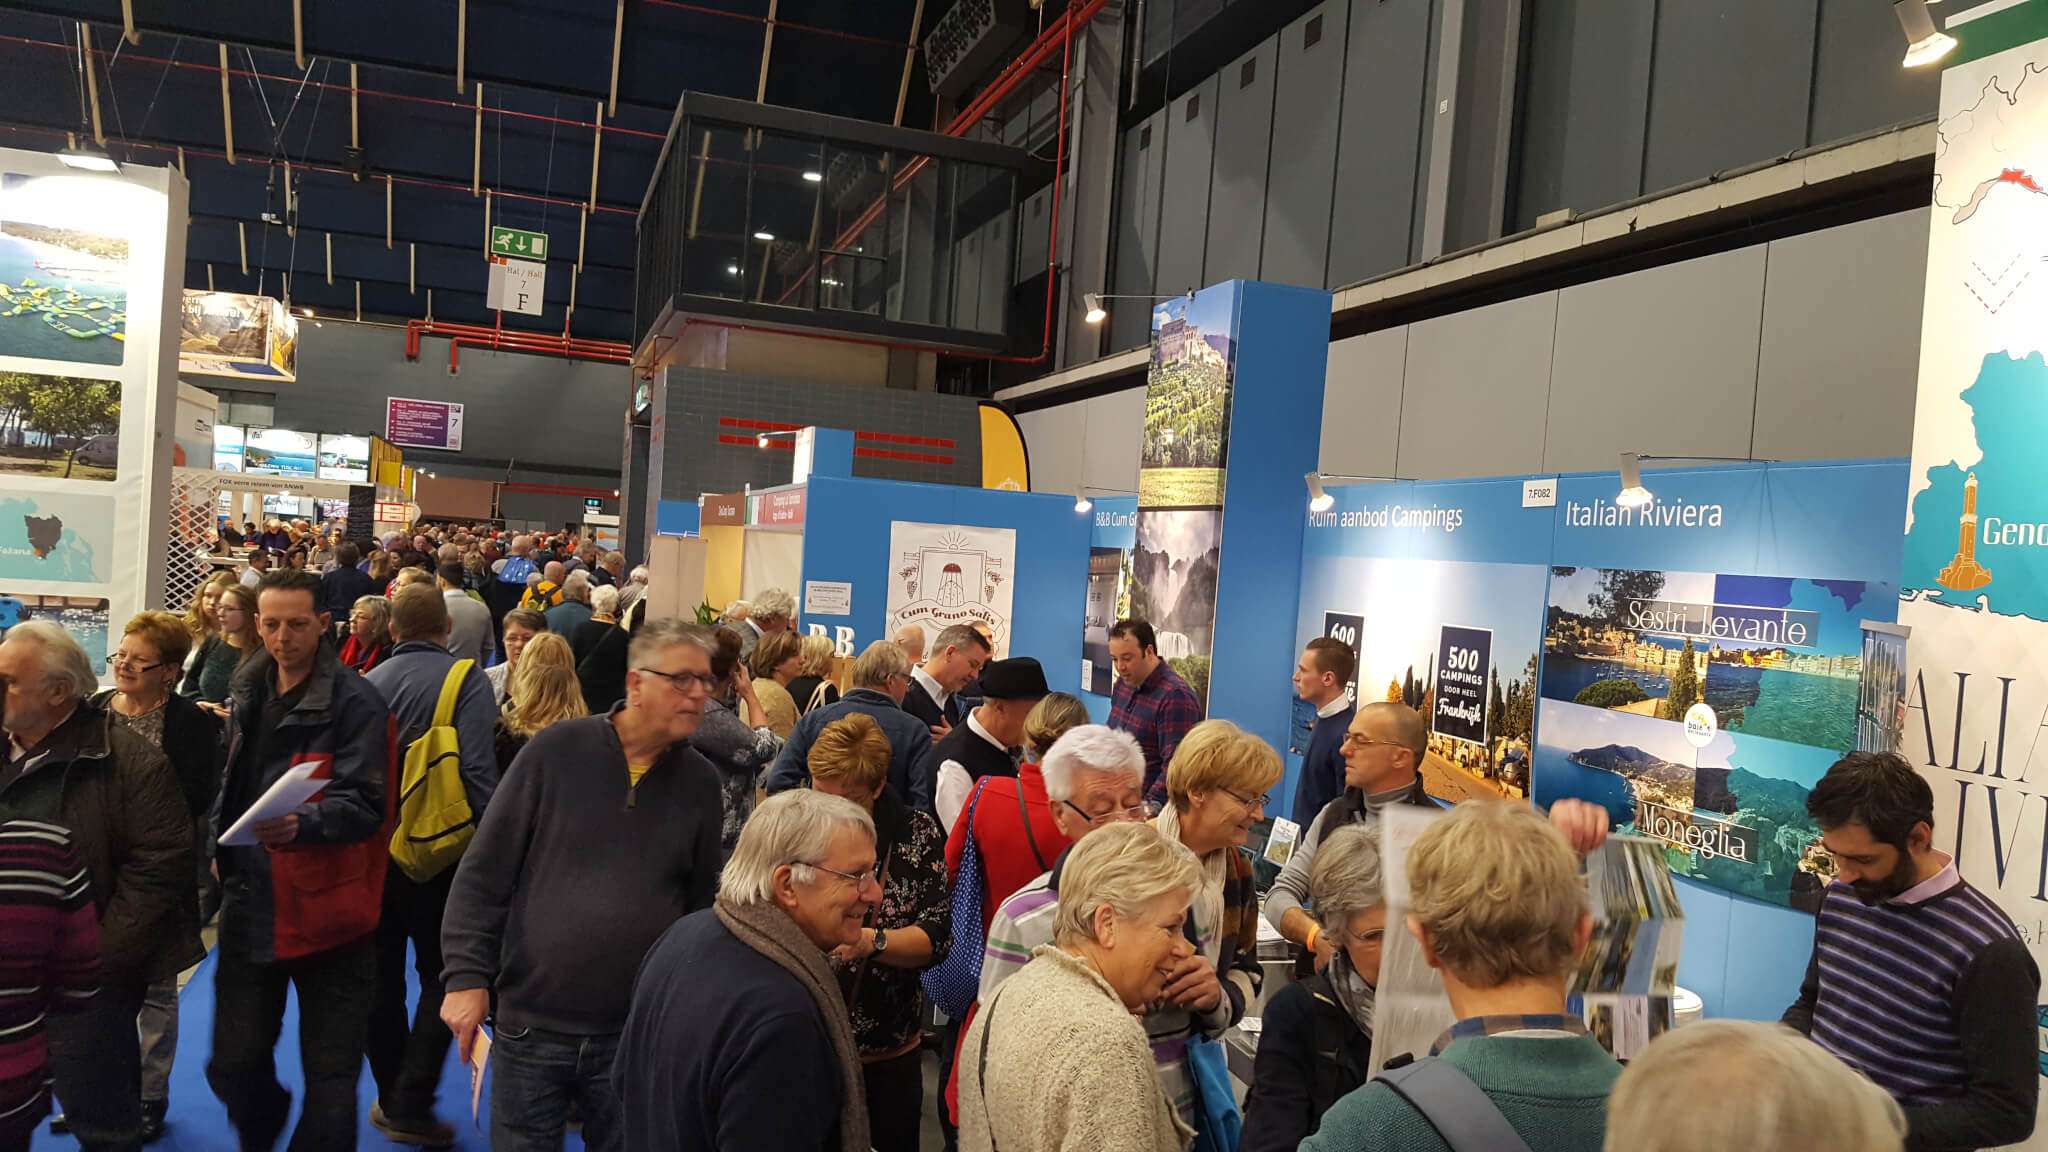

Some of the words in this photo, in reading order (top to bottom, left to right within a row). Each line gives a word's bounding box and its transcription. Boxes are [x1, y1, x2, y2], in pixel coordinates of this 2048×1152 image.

[507, 266, 520, 275] Hal
[527, 270, 543, 279] Hall
[521, 280, 527, 288] 7
[517, 293, 529, 310] F
[451, 418, 459, 428] 7
[1528, 488, 1552, 500] 7.F082
[1095, 512, 1111, 527] B&B
[1112, 512, 1128, 527] Cum
[1308, 509, 1338, 528] Ruim
[1340, 505, 1388, 528] aanbod
[1391, 504, 1463, 533] Campings
[1565, 498, 1632, 527] Italian
[1639, 497, 1723, 527] Riviera
[900, 606, 929, 620] Cum
[928, 607, 968, 620] Grano
[969, 608, 997, 626] Salis
[1627, 600, 1688, 633] Sestri
[1700, 605, 1807, 645] Levante
[1330, 622, 1356, 646] 600
[1447, 645, 1479, 672] 500
[1440, 669, 1483, 686] CAMPINGS
[1444, 685, 1461, 695] DOOR
[1461, 688, 1478, 698] HEEL
[1437, 697, 1482, 726] Frankrijk
[1641, 803, 1747, 860] Moneglia
